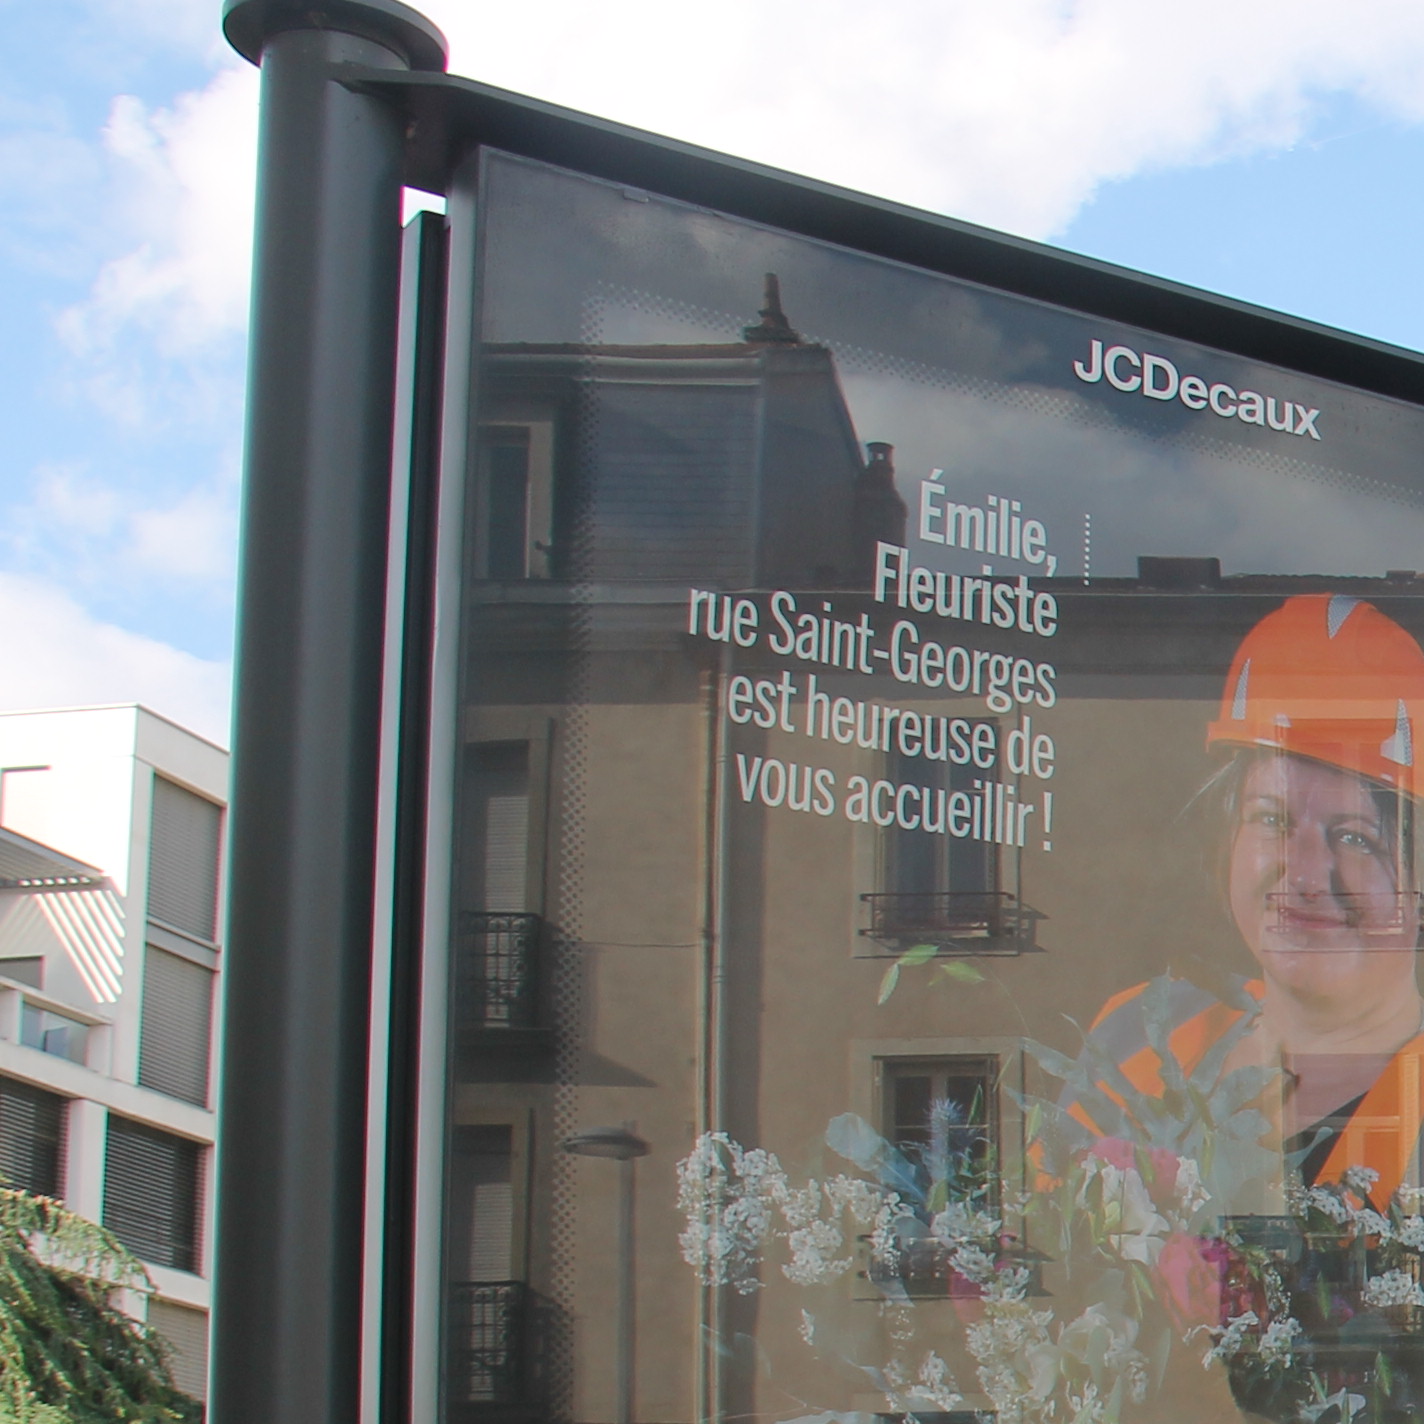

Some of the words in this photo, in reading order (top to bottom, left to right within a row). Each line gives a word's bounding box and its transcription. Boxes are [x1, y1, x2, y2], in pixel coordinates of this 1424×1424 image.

[1073, 338, 1322, 442] JCDecaux
[920, 469, 1058, 576] Émilie,
[874, 540, 1058, 637] Fleuriste
[688, 585, 758, 648] rue
[769, 590, 1057, 713] Saint-Georges
[728, 669, 796, 731] est
[806, 673, 995, 769] heureuse
[1008, 716, 1056, 779] de
[736, 751, 836, 817] vous
